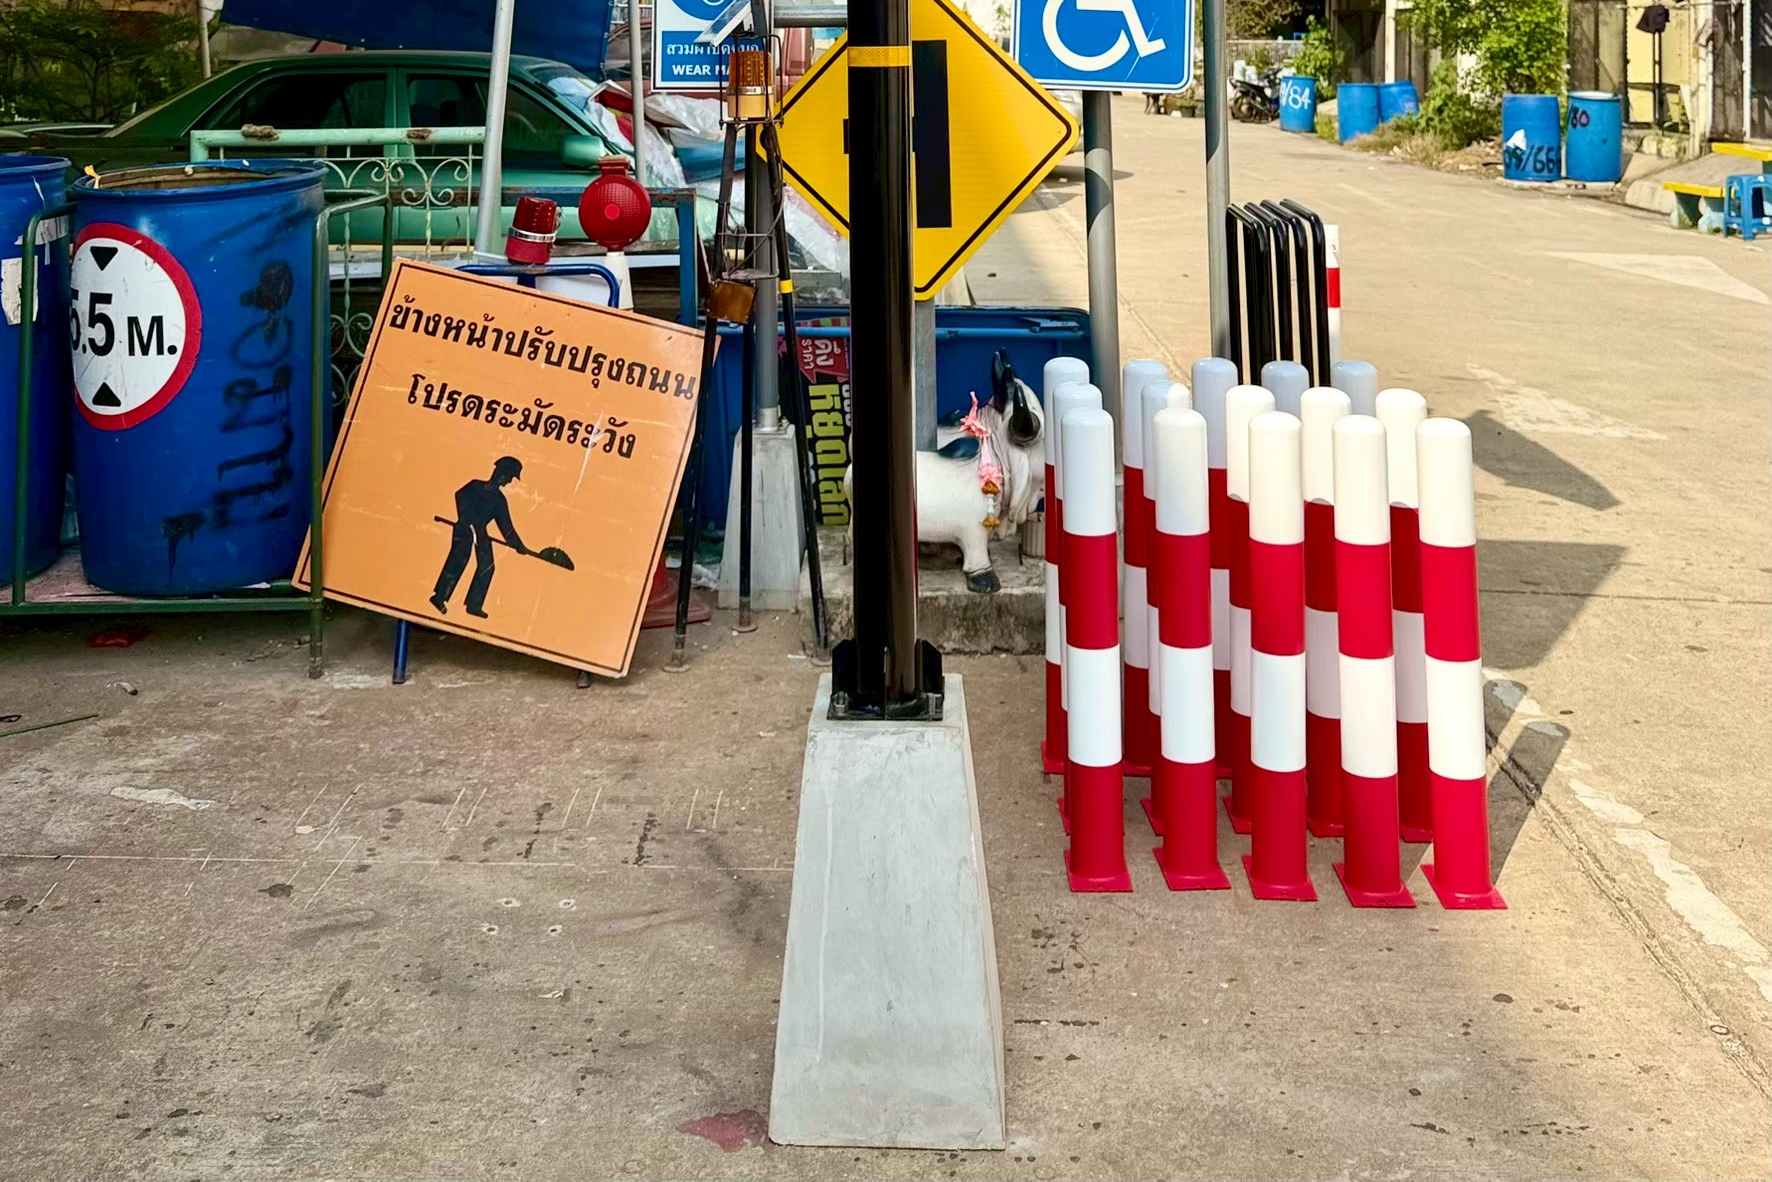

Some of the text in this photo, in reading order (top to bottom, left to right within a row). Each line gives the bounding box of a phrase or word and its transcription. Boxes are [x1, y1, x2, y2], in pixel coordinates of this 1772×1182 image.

[672, 64, 712, 76] WEAR
[127, 315, 178, 357] M.
[389, 294, 697, 401] ข้างหน้าปรับปรุงถนน
[407, 373, 636, 459] โปรดระมัดระวัง
